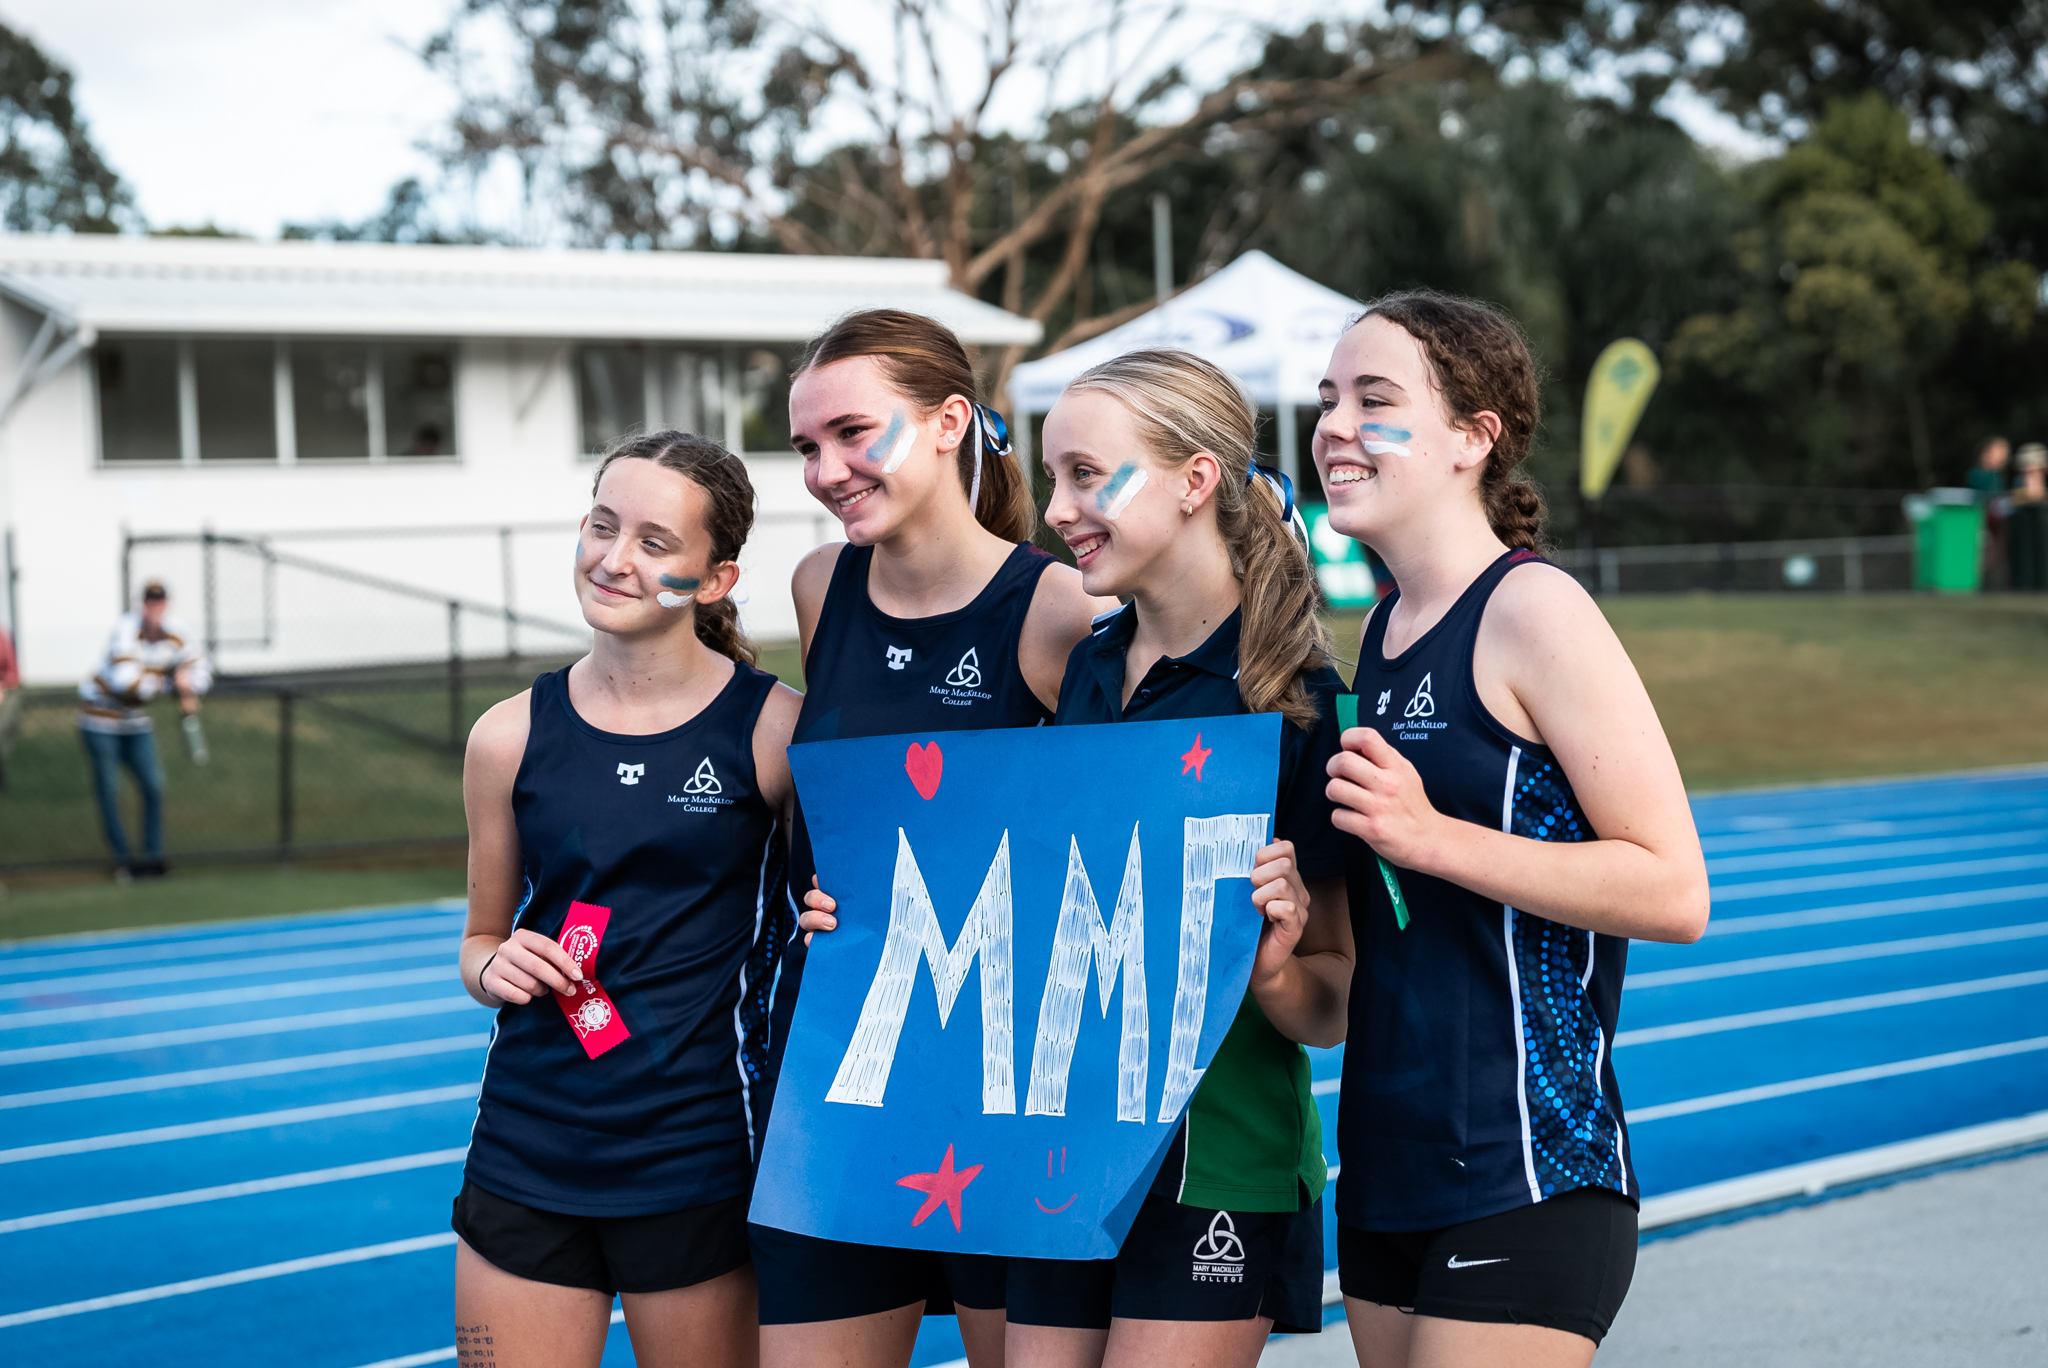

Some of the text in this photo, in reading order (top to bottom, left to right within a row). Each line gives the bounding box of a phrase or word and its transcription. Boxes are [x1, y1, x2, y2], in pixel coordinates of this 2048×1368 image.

[929, 686, 950, 695] MARY
[942, 697, 973, 706] COLLEGE
[1400, 731, 1428, 740] COLLEGE
[667, 795, 689, 803] MARY
[683, 804, 718, 813] COLLEGE
[1192, 1264, 1243, 1274] MARY MACKILLOP
[1192, 1274, 1243, 1283] COLLEGE
